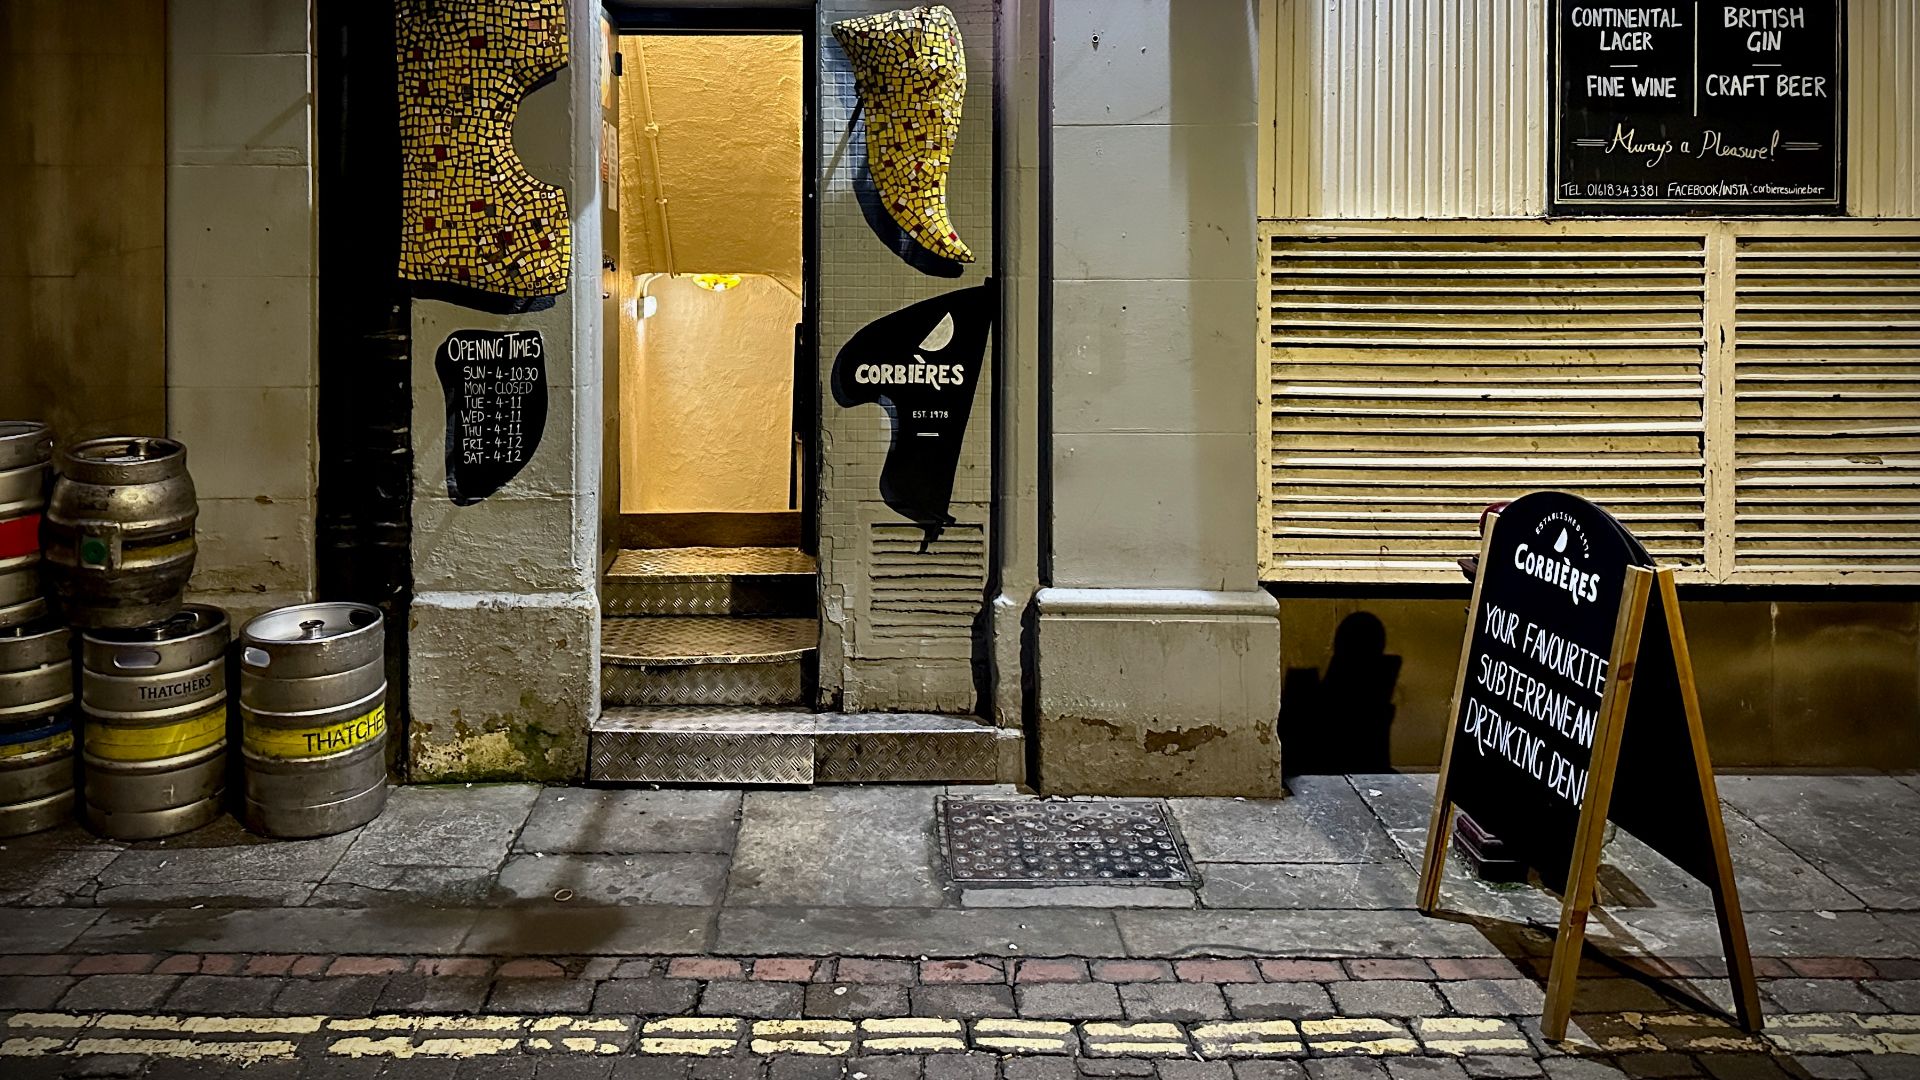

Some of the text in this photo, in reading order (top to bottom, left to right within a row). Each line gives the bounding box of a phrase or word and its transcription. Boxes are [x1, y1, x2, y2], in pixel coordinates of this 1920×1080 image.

[1571, 7, 1682, 28] CONTINENTAL
[1724, 7, 1804, 28] BRITISH
[1600, 31, 1653, 51] LAGER
[1747, 31, 1781, 51] GIN
[1587, 75, 1676, 97] FINE WINE
[1706, 74, 1826, 97] CRAFT BEER
[1605, 122, 1780, 168] Always a Pleasure!
[1587, 183, 1659, 197] 01618343381
[448, 333, 541, 362] OPENING TIMES
[463, 365, 486, 380] SUN
[855, 354, 965, 391] CORBIÈRES
[464, 381, 486, 395] MON
[495, 381, 533, 395] CLOSED
[464, 395, 485, 409] TUE
[460, 409, 485, 423] WED
[912, 410, 949, 419] EST. 1978
[462, 423, 482, 437] THU
[462, 437, 484, 451] FRI
[463, 450, 484, 464] SAT
[1535, 511, 1581, 535] ESTABLISHED
[1514, 543, 1600, 605] CORBIÈRES
[1485, 602, 1609, 698] YOUR FAVOURITE
[138, 673, 211, 700] THATCHERS
[1477, 654, 1598, 749] SUBTERRANEAN
[302, 705, 386, 753] THATCHE
[1464, 697, 1546, 780] DRINKING
